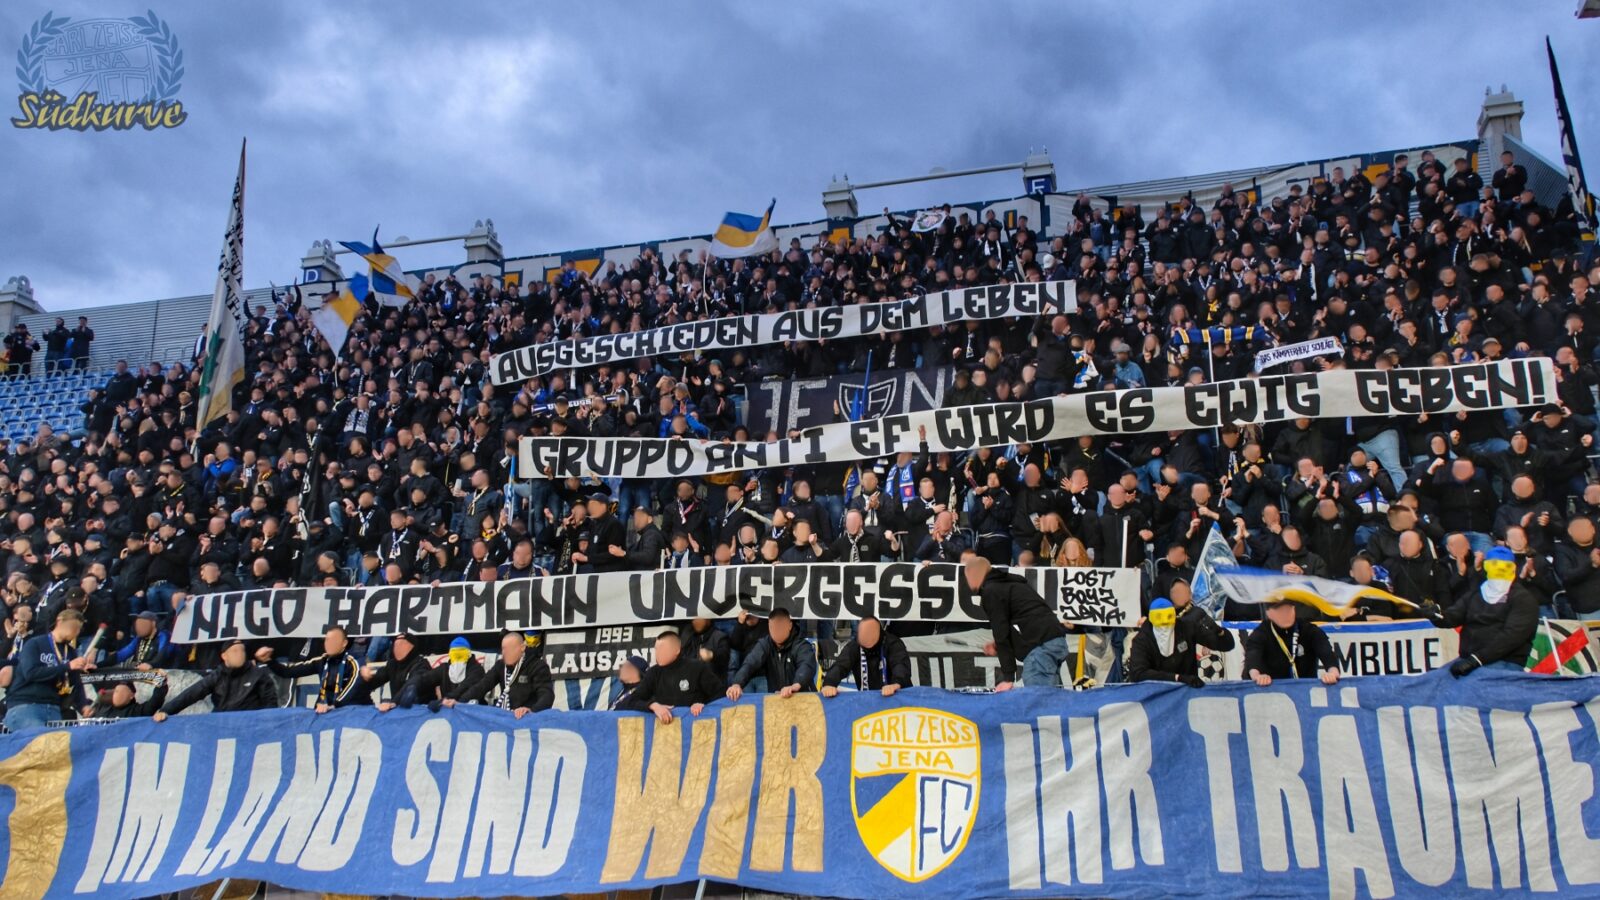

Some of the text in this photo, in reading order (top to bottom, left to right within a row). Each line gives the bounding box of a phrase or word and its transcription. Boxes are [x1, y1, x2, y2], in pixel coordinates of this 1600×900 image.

[305, 269, 319, 283] D
[498, 281, 1066, 381] AUSGESCHIEDEN AUS DEM LEBEN
[531, 438, 694, 476] GRUPPO
[850, 415, 911, 456] EF
[935, 402, 1054, 450] WIRD
[1086, 390, 1155, 432] ES
[1186, 374, 1320, 426] EWIG
[1355, 361, 1547, 413] GEBEN!
[1063, 568, 1116, 588] LOST
[189, 589, 306, 640] NICO
[322, 576, 599, 636] HARTMANN
[1061, 587, 1118, 607] BOYZ
[595, 626, 633, 644] 1993
[859, 714, 972, 743] CARL ZEISS
[877, 751, 954, 769] JENA
[74, 742, 190, 893] IM
[174, 727, 382, 876] LAND
[392, 718, 588, 883] SIND
[600, 694, 827, 883] WIR
[1001, 702, 1165, 890] IHR
[1188, 687, 1600, 900] TRÄUME
[918, 776, 972, 871] FC
